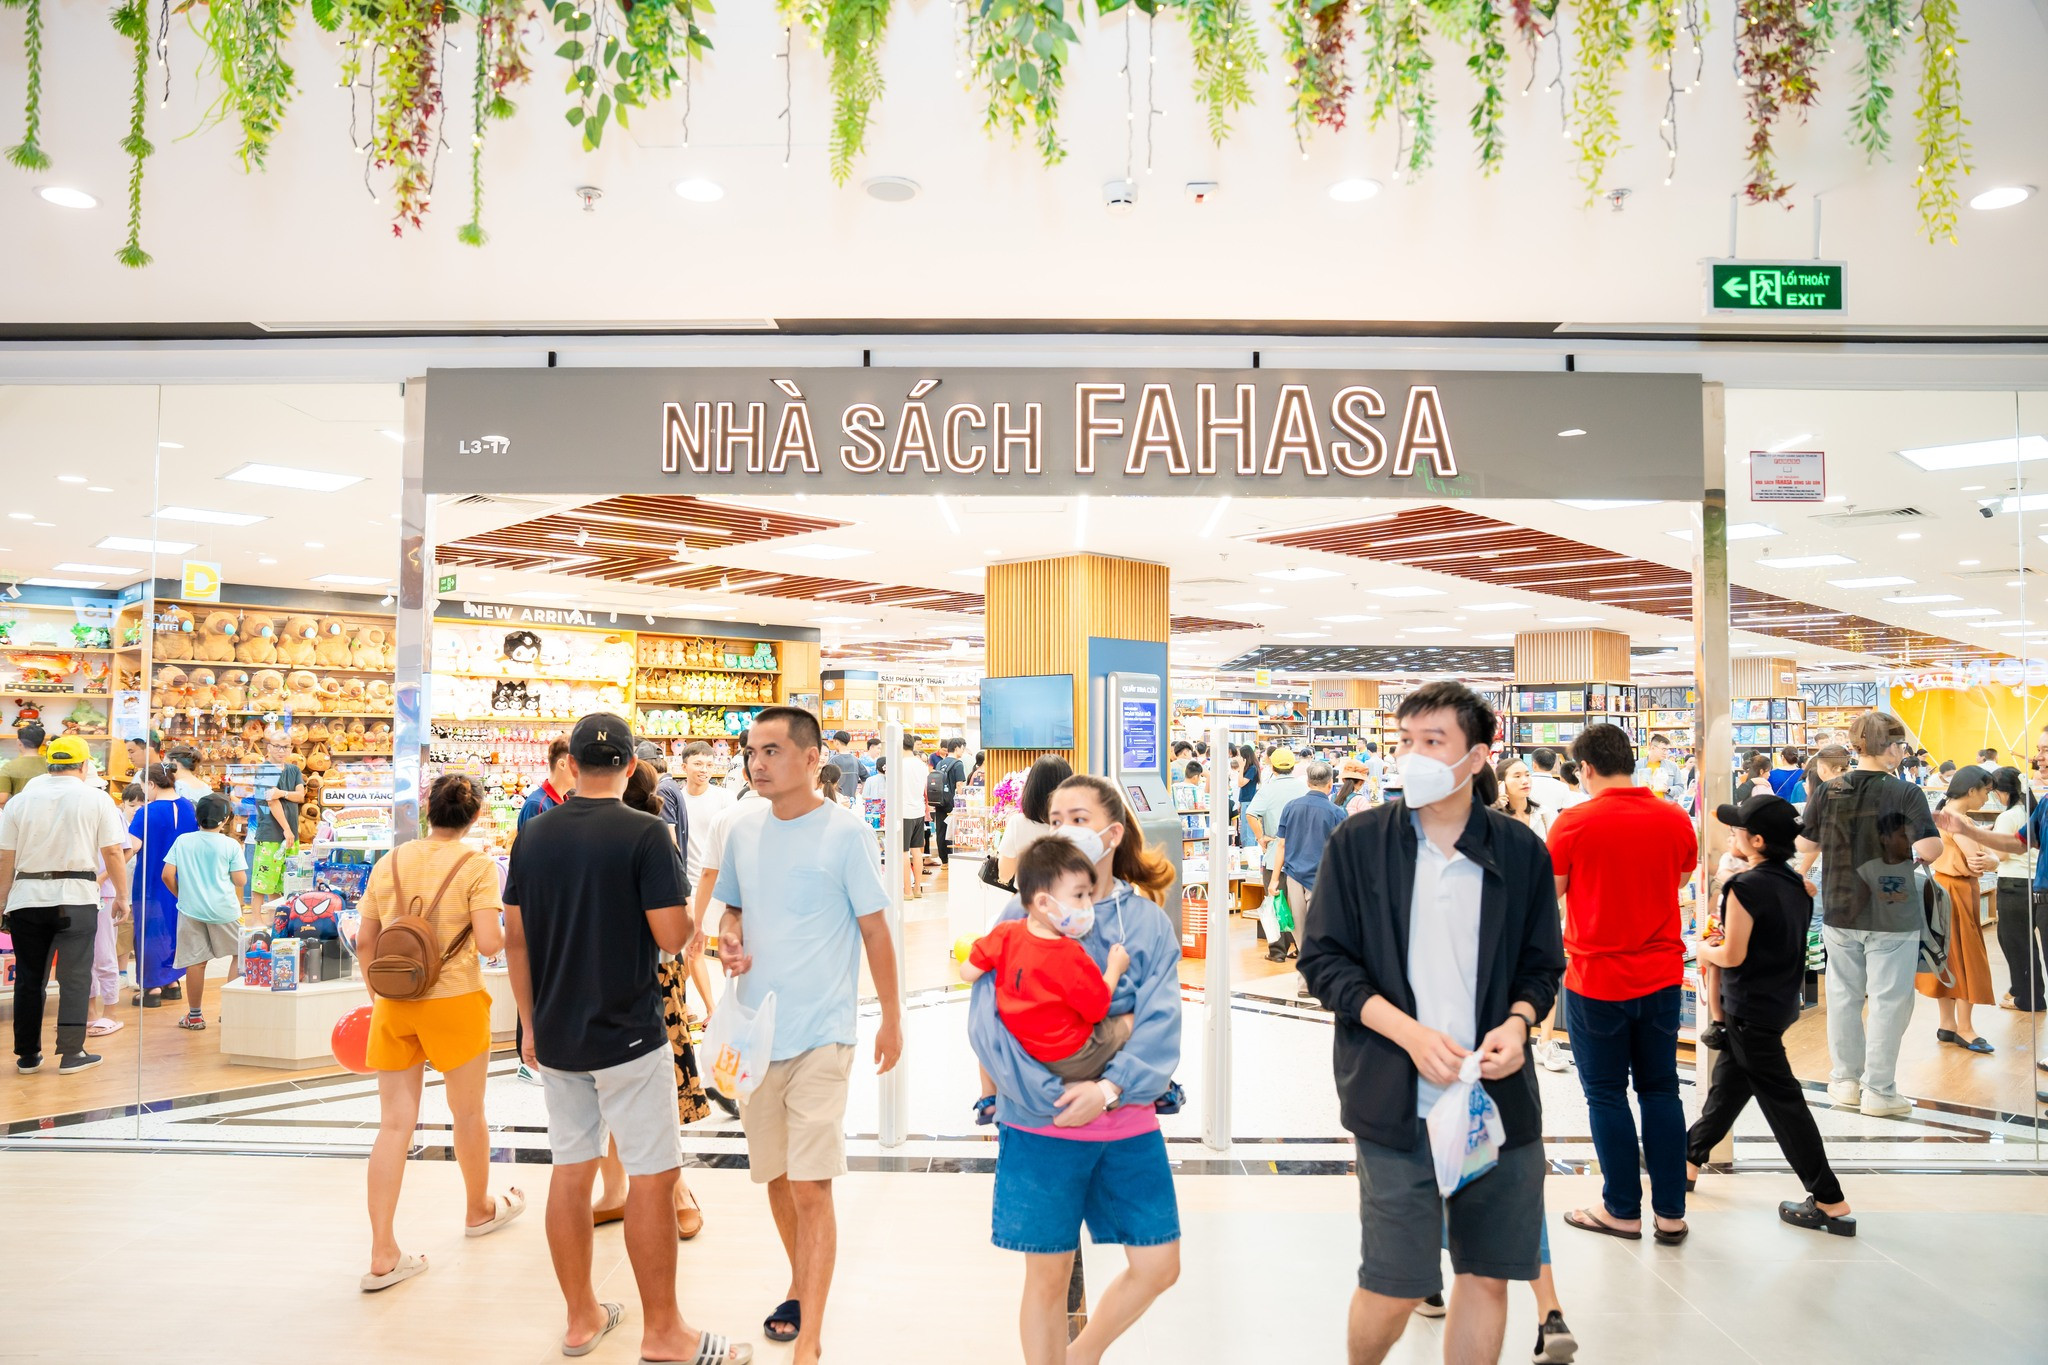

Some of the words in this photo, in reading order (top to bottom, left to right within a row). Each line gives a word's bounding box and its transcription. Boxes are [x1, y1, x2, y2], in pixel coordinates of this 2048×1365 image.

[1781, 270, 1798, 286] LỐI
[1799, 272, 1831, 286] THOÁT
[1786, 293, 1826, 306] EXIT
[661, 378, 823, 475] NHÀ
[839, 378, 1043, 476] SÁCH
[1074, 382, 1459, 479] FAHASA
[459, 437, 511, 455] L3-17
[185, 563, 218, 597] D
[470, 605, 513, 620] NEW
[521, 609, 596, 626] ARRIVAL
[596, 731, 608, 741] N
